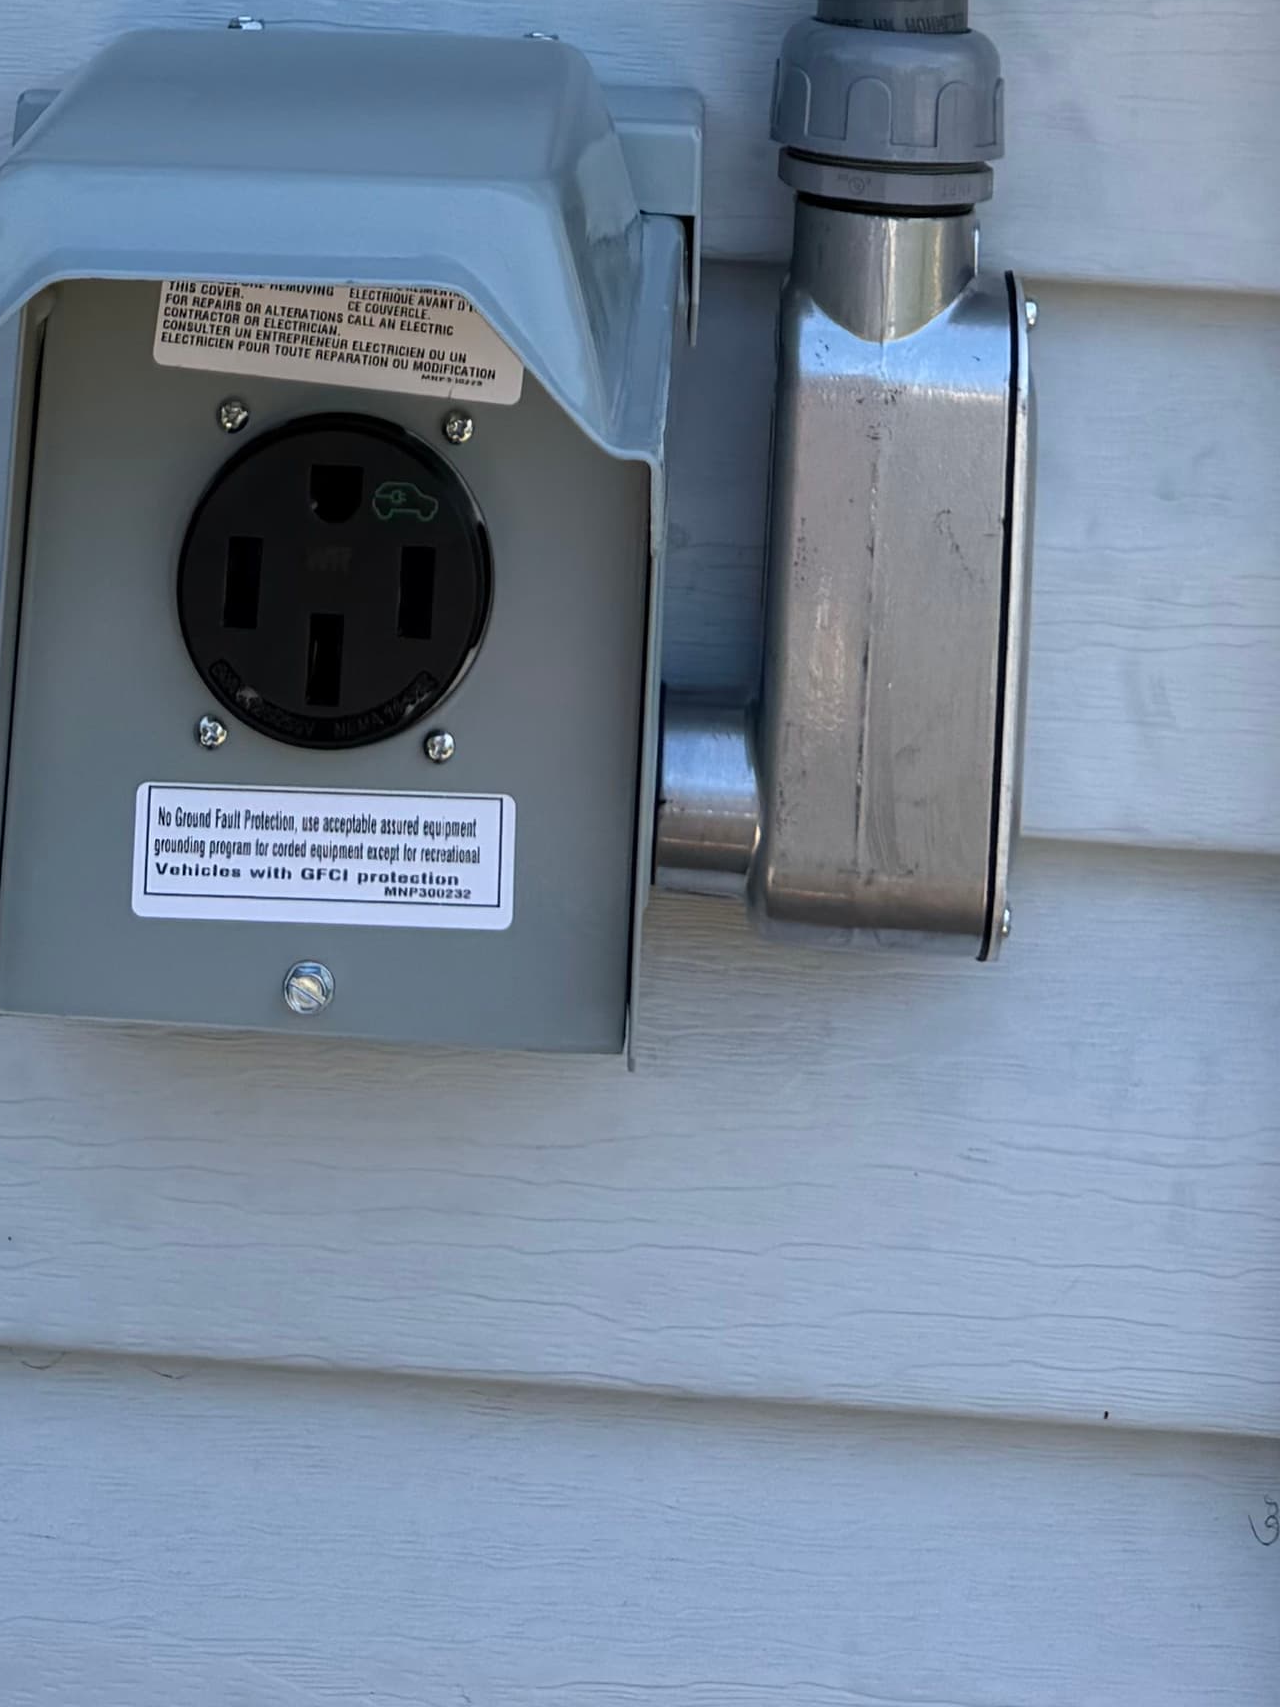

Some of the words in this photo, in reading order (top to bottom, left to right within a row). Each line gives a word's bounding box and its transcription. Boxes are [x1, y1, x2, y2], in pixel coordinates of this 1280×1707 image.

[170, 280, 196, 293] THIS
[201, 284, 244, 299] COVER.
[349, 287, 413, 305] ELECTRIQUE
[418, 296, 454, 310] AVANT
[164, 306, 240, 324] CONTRACTOR
[244, 315, 260, 327] OR
[264, 317, 340, 336] ELECTRICIAN.
[165, 293, 188, 306] FOR
[192, 296, 242, 312] REPAIRS
[245, 302, 262, 314] OR
[265, 305, 343, 324] ALTERATIONS
[347, 314, 375, 327] CALL
[379, 317, 396, 330] AN
[400, 320, 454, 336] ELECTRIC
[347, 301, 361, 312] CE
[365, 303, 430, 320] COUVERCLE.
[161, 331, 234, 350] ELECTRICIEN
[238, 340, 270, 354] POUR
[275, 344, 311, 359] TOUTE
[315, 349, 389, 367] REPARATION
[392, 358, 409, 370] OU
[413, 360, 496, 380] MODIFICATION
[163, 319, 231, 337] CONSULTER
[235, 327, 252, 339] UN
[256, 329, 348, 350] ENTREPRENEUR
[352, 340, 425, 359] ELECTRICIEN
[429, 349, 445, 361] OU
[449, 351, 467, 364] UN
[158, 806, 172, 827] No
[175, 806, 212, 829] Ground
[215, 808, 241, 830] Fault
[244, 809, 298, 833] Protection,
[302, 816, 319, 832] use
[323, 813, 377, 837] acceptable
[380, 815, 419, 836] assured
[423, 819, 477, 840] equipment
[154, 836, 206, 858] grounding
[209, 840, 251, 859] program
[255, 838, 269, 856] for
[272, 839, 307, 858] corded
[310, 841, 364, 862] equipment
[367, 844, 400, 865] except
[403, 843, 417, 862] for
[420, 846, 480, 864] recreational
[155, 862, 241, 878] Vehicles
[250, 867, 292, 880] with
[301, 868, 348, 881] GFCI
[357, 871, 459, 886] protection
[384, 886, 471, 899] MNP300232
